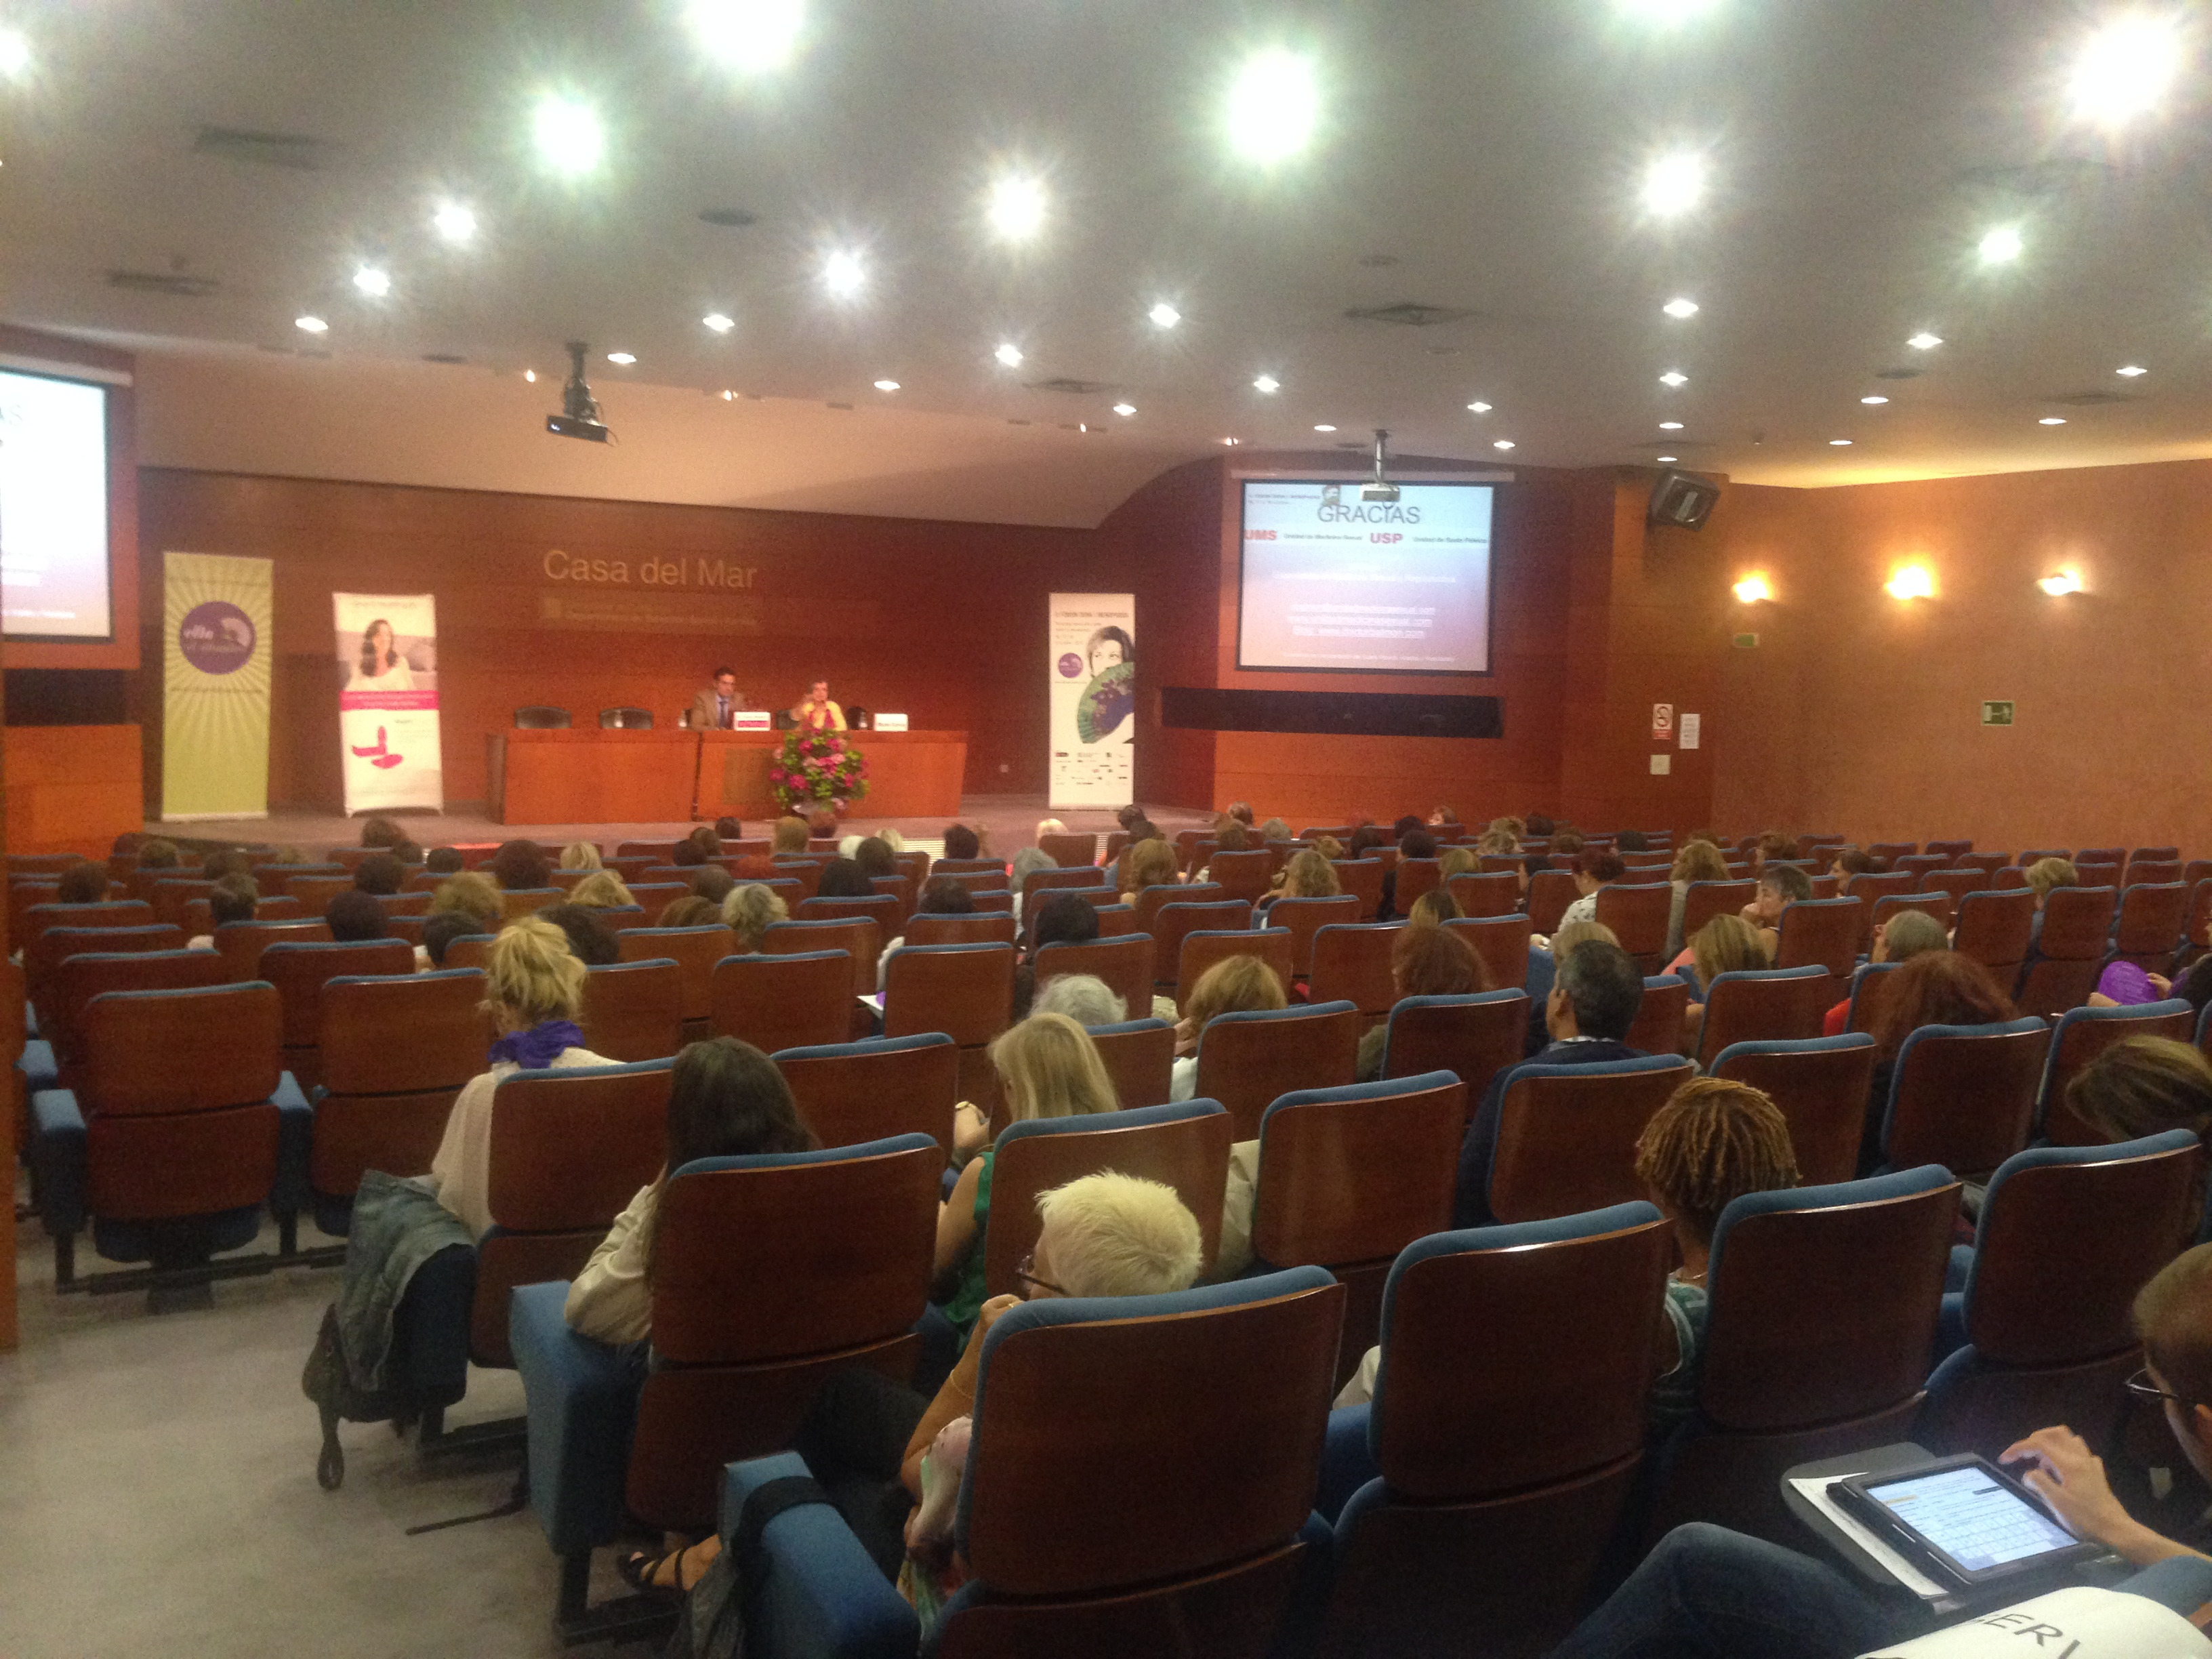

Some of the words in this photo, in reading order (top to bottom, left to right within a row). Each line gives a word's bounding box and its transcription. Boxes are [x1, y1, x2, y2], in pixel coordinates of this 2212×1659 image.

[1317, 504, 1420, 525] GRACIAS
[1370, 533, 1403, 544] USP
[544, 549, 629, 583] Casa
[640, 556, 687, 585] del
[697, 558, 758, 588] Mar
